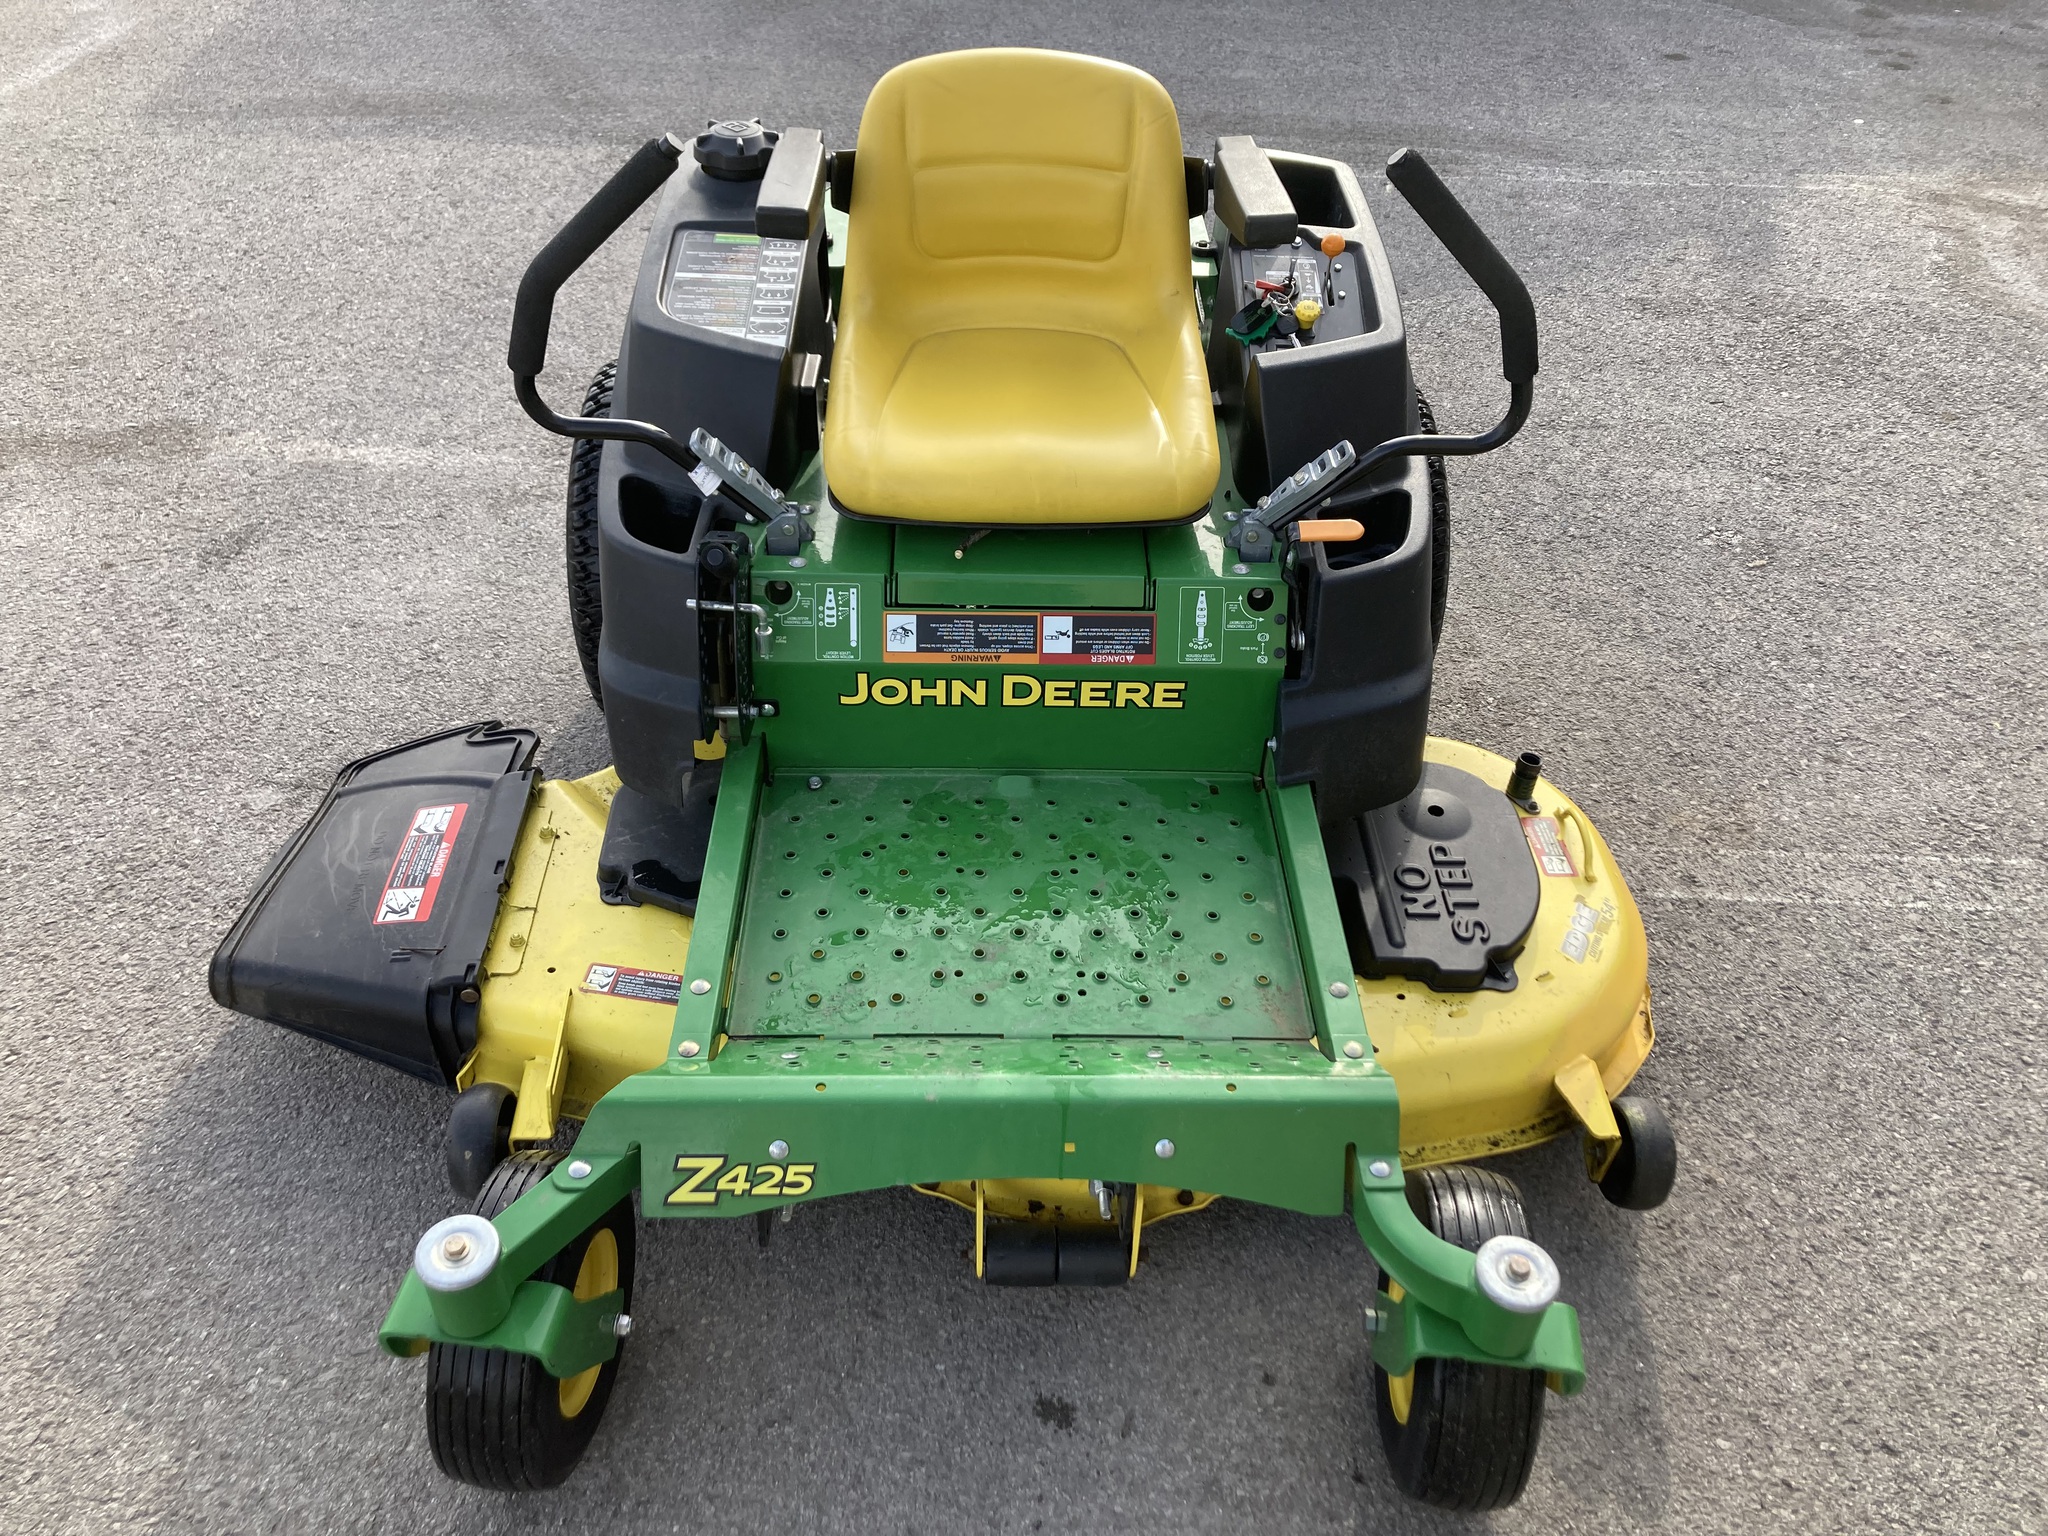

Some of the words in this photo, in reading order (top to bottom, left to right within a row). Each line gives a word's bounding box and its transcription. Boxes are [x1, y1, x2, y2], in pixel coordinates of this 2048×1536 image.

[839, 672, 990, 706] JOHN
[1001, 674, 1188, 709] DEERE
[430, 849, 448, 878] DANGER
[1393, 862, 1441, 922] NO
[1429, 841, 1491, 943] STEP
[1560, 903, 1600, 964] EDGE
[646, 972, 679, 981] DANGER
[663, 1154, 818, 1206] Z425
